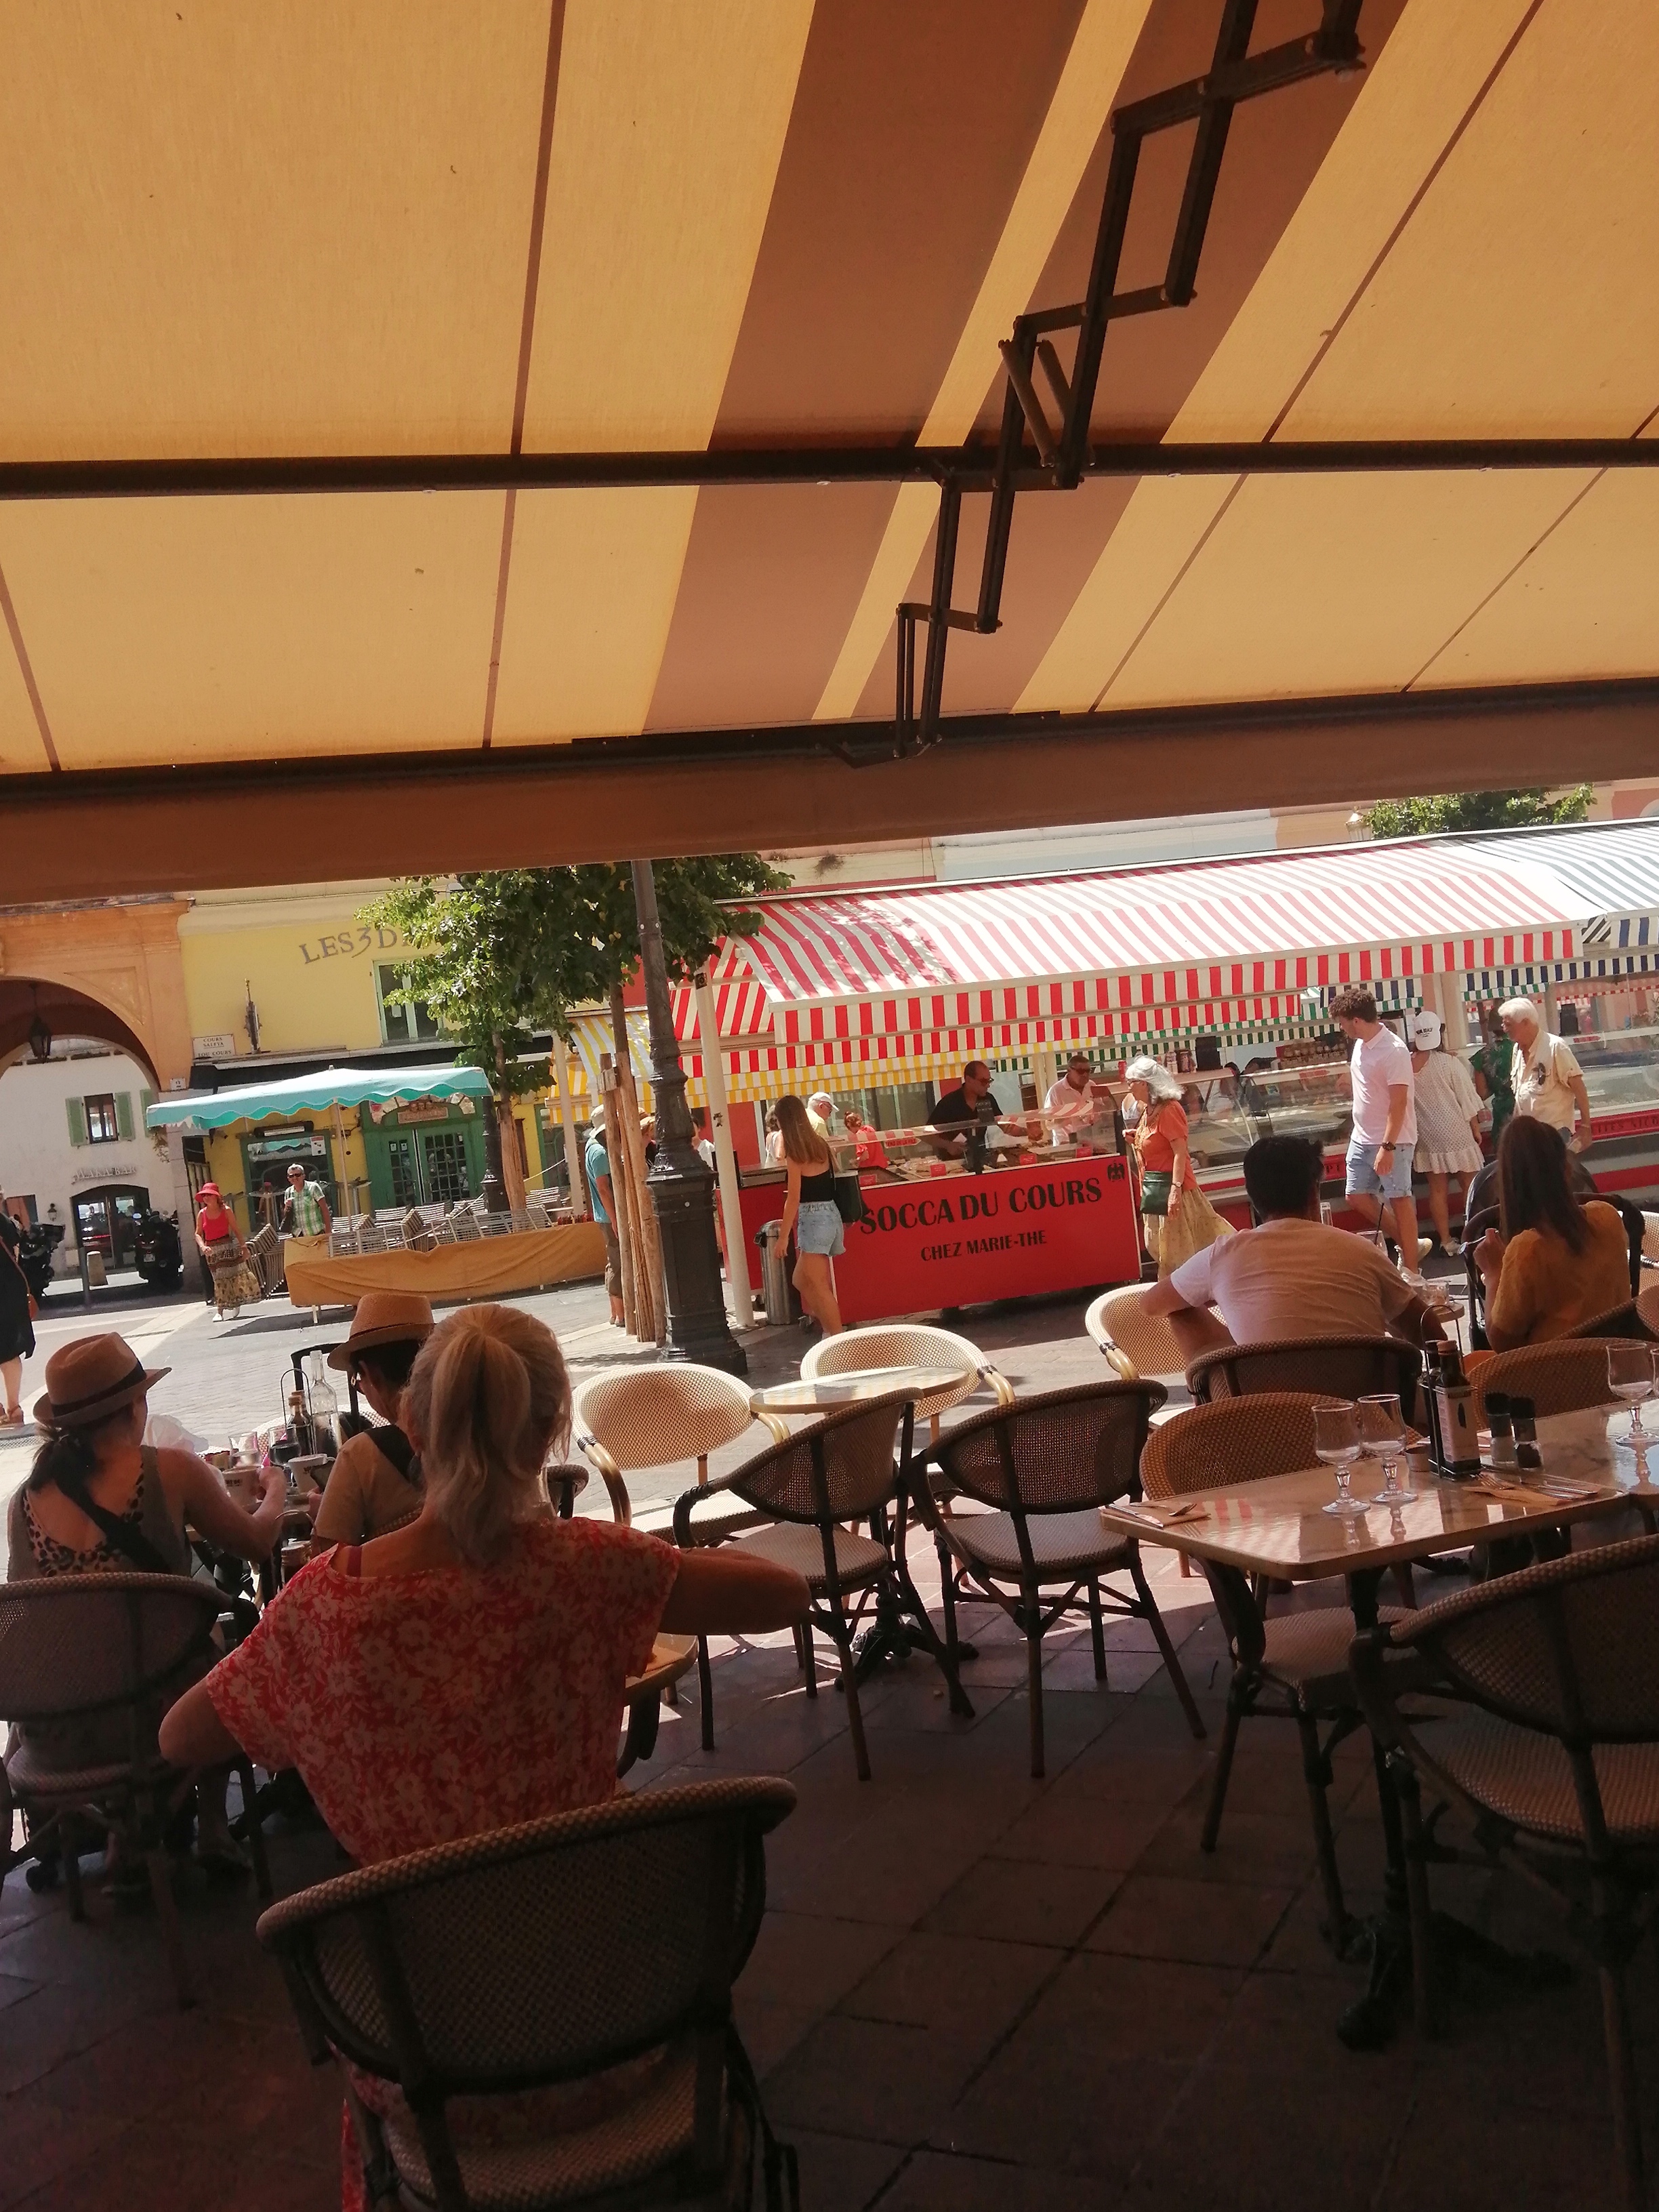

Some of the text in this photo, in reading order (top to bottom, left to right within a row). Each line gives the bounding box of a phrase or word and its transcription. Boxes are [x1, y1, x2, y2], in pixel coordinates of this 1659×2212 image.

[299, 932, 354, 964] LES
[351, 926, 371, 958] 3
[859, 1177, 1102, 1235] SOCCA DU COURS
[920, 1229, 1047, 1261] CHEZ MARIE-THE
